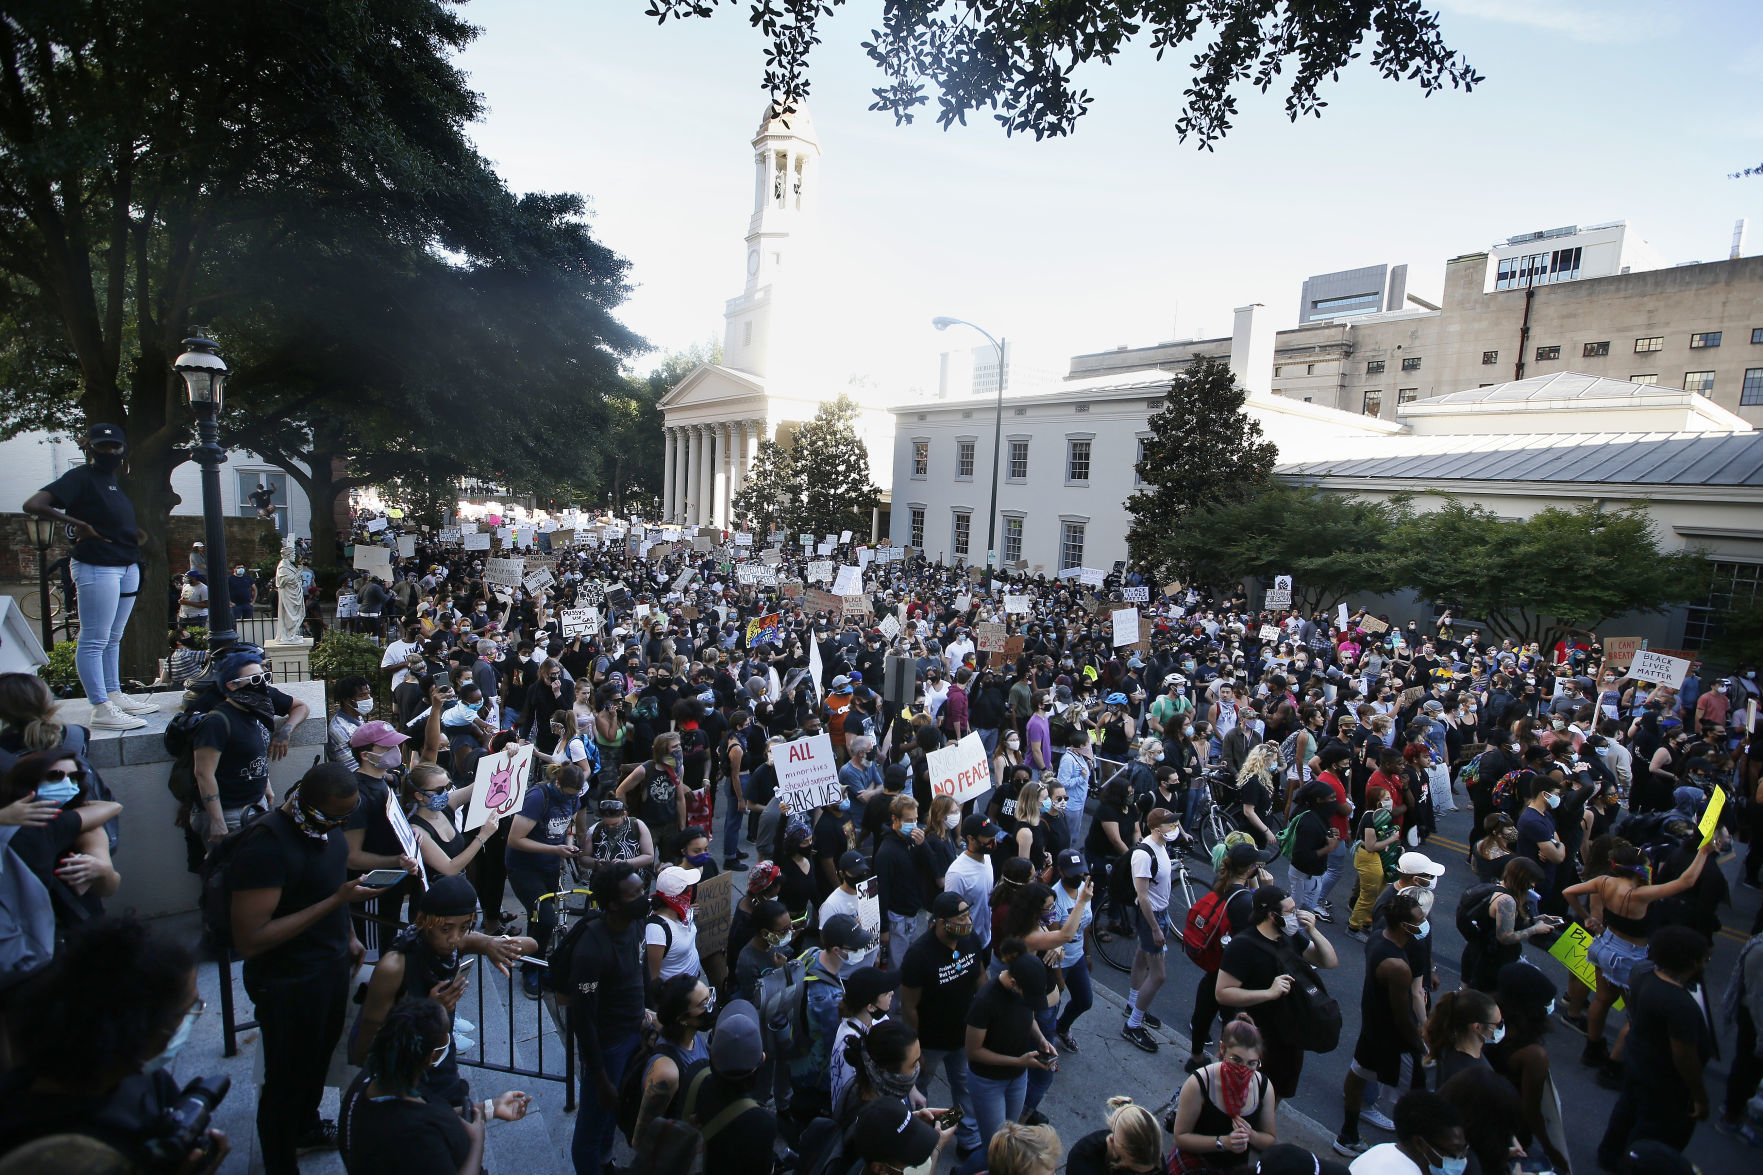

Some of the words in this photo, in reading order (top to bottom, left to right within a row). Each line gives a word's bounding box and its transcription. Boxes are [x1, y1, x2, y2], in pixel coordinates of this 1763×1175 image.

[524, 568, 546, 584] Silence
[576, 584, 604, 594] BLACK
[578, 590, 604, 598] LIVES
[564, 624, 594, 636] BLM
[1608, 651, 1635, 660] BREATH
[1644, 653, 1672, 666] BLACK
[1642, 661, 1670, 672] LIVES
[1637, 668, 1672, 680] MATTER
[790, 742, 814, 763] ALL
[785, 763, 828, 779] minorities
[785, 778, 810, 791] should
[810, 774, 836, 787] support
[934, 779, 955, 796] NO
[958, 760, 989, 792] PEACE
